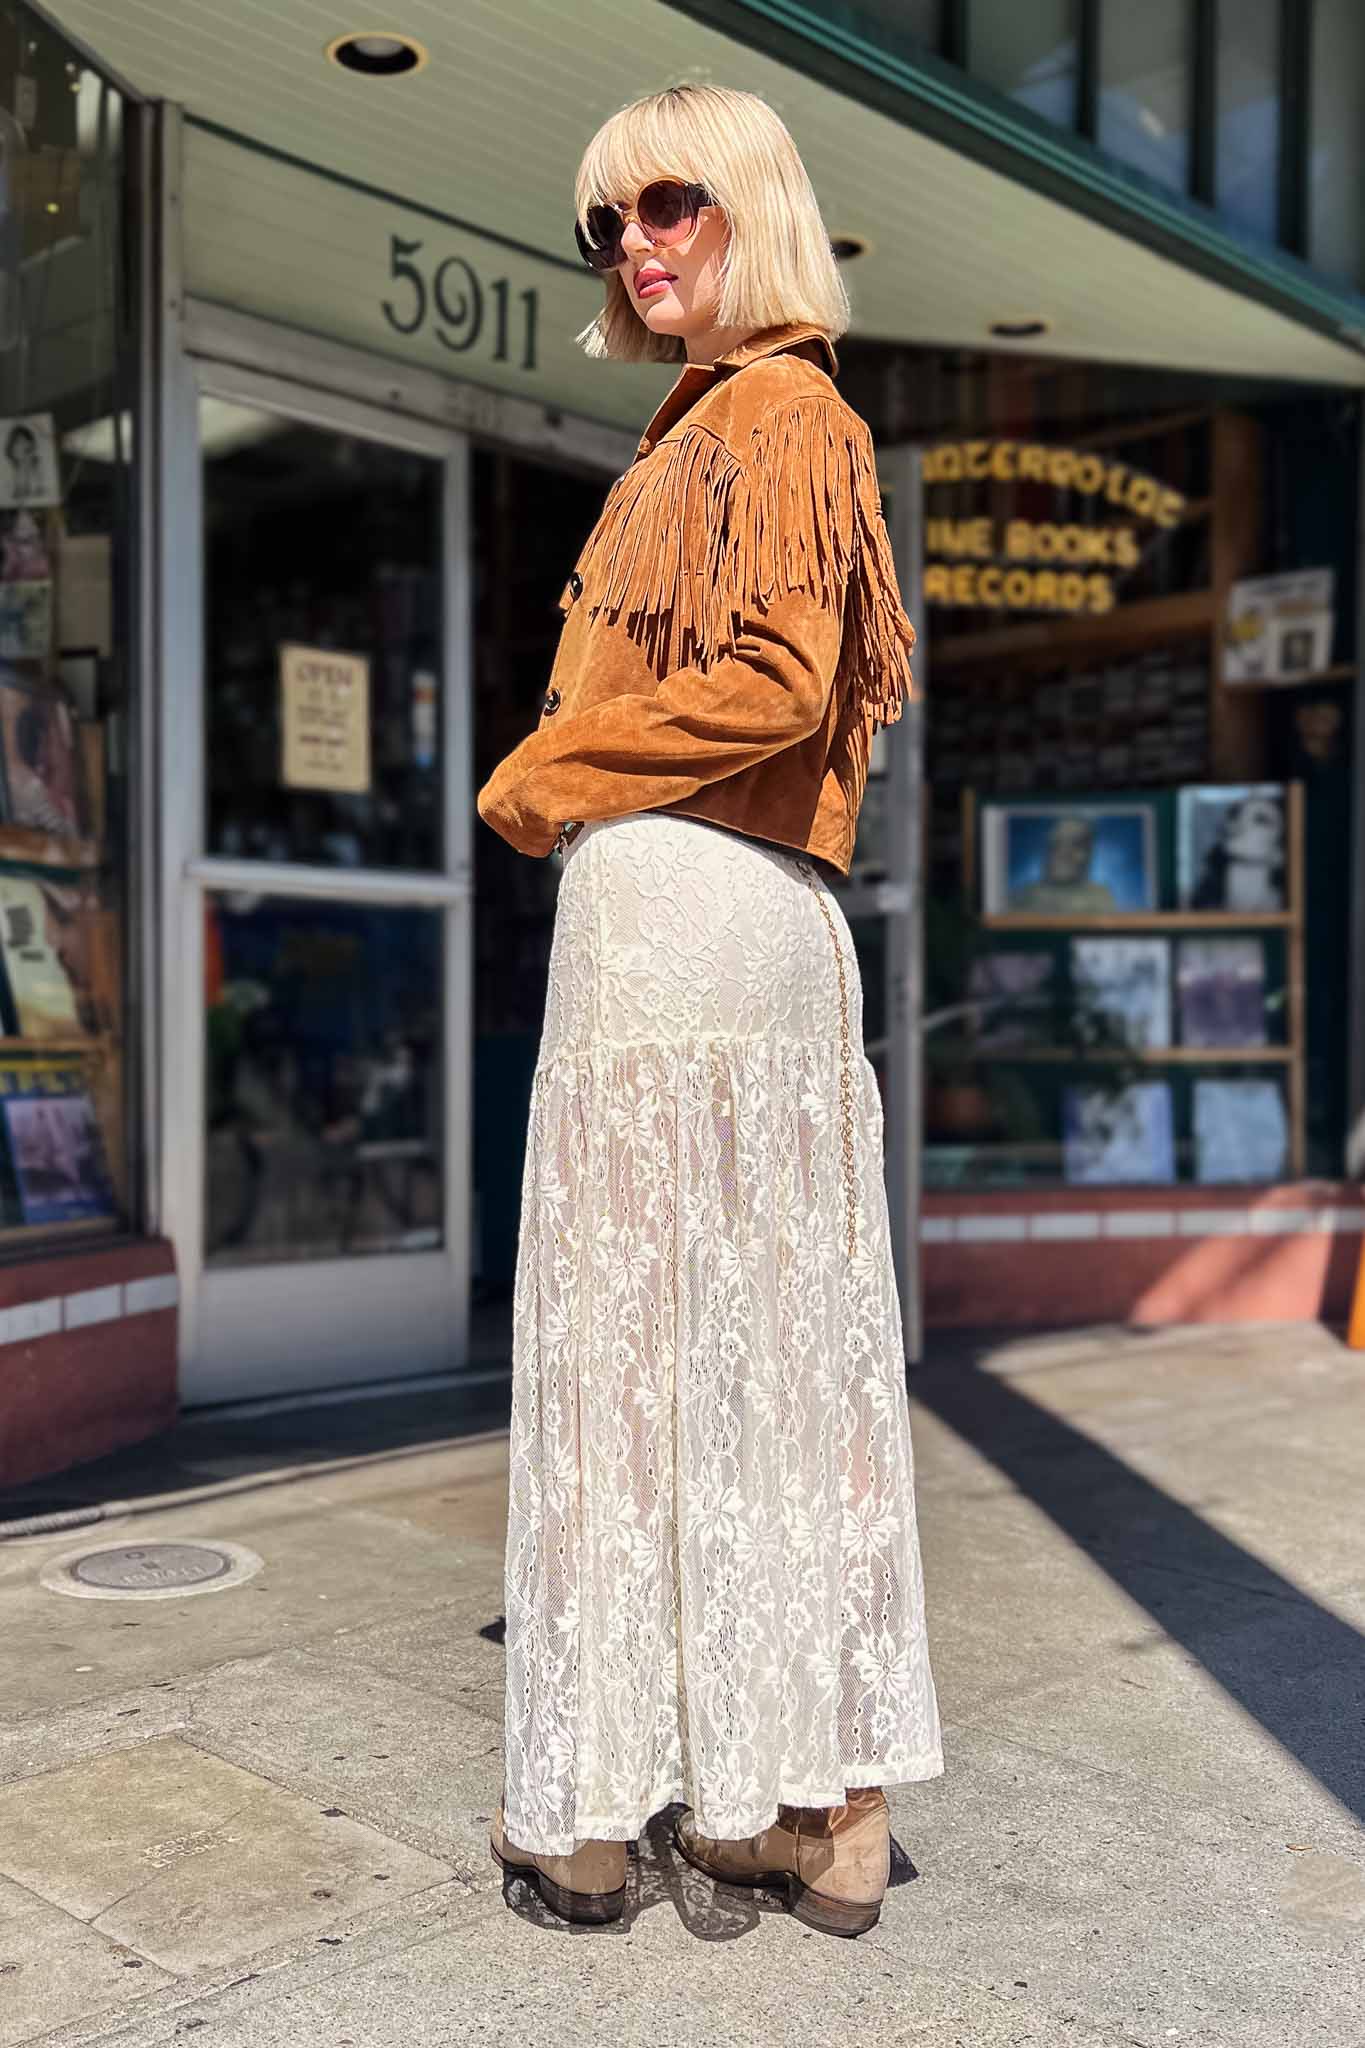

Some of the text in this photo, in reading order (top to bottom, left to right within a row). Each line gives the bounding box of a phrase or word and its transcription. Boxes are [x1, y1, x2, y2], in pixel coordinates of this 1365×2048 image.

[382, 234, 538, 370] 5911
[1005, 520, 1139, 566] BOOKS
[923, 565, 1113, 613] RECORDS
